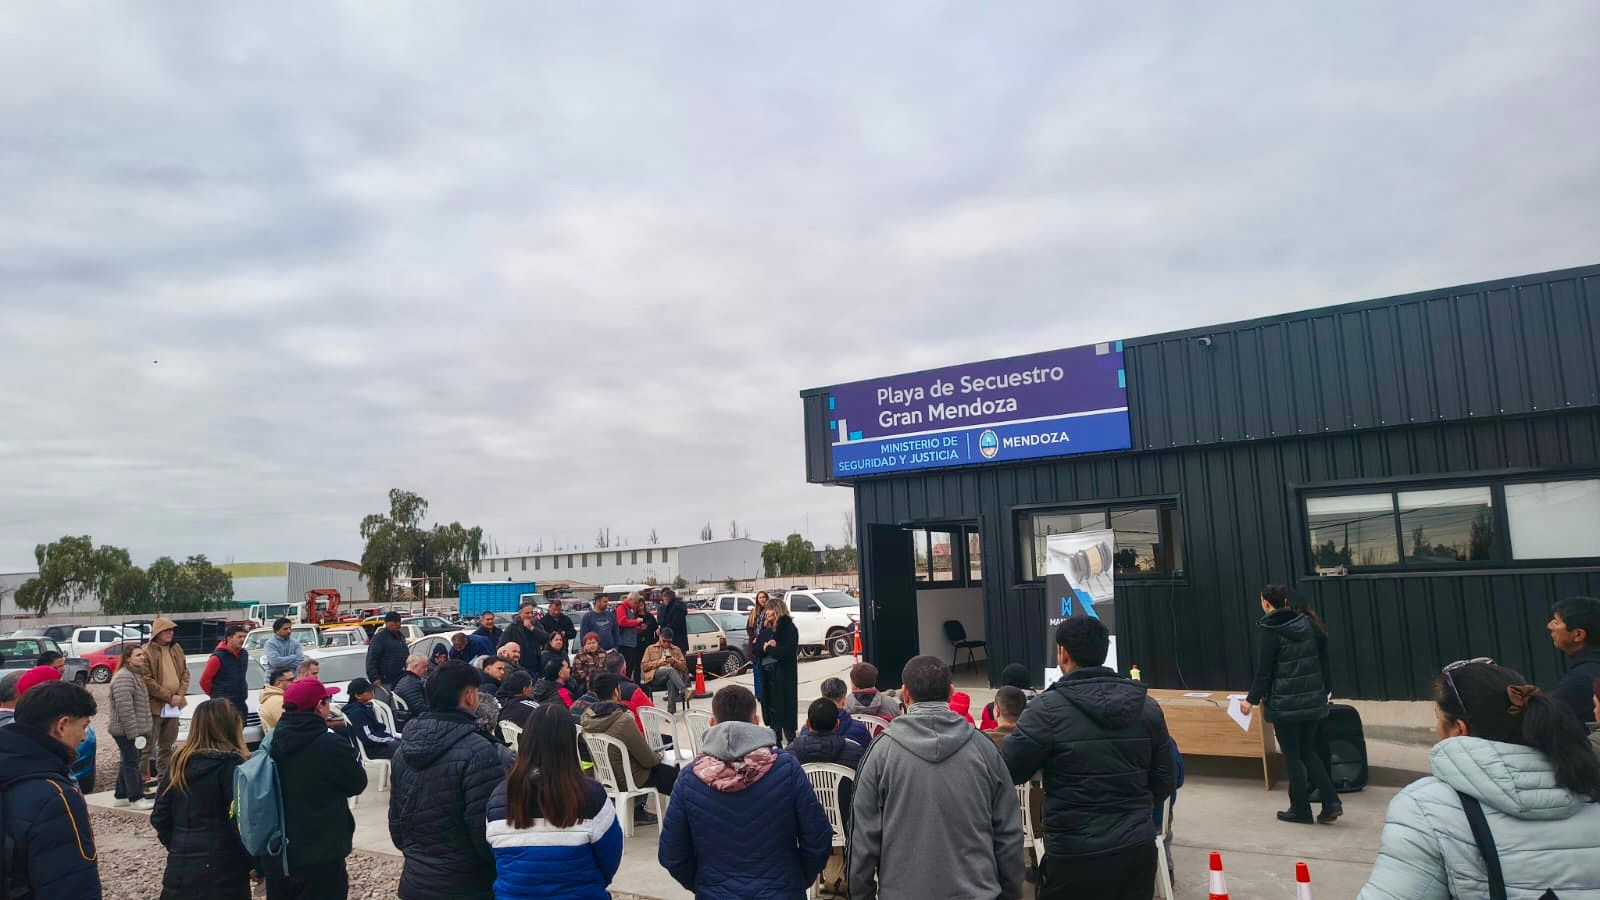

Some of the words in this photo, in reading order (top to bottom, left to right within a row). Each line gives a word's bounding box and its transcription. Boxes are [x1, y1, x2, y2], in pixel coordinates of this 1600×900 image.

[877, 386, 924, 406] Playa
[930, 379, 954, 398] de
[960, 366, 1064, 393] Secuestro
[879, 410, 923, 428] Gran
[928, 397, 1017, 422] Mendoza
[880, 438, 940, 454] MINISTERIO
[943, 436, 959, 447] DE
[1003, 431, 1070, 448] MENDOZA
[838, 455, 897, 472] SEGURIDAD
[899, 455, 907, 465] Y
[910, 449, 959, 464] JUSTICIA
